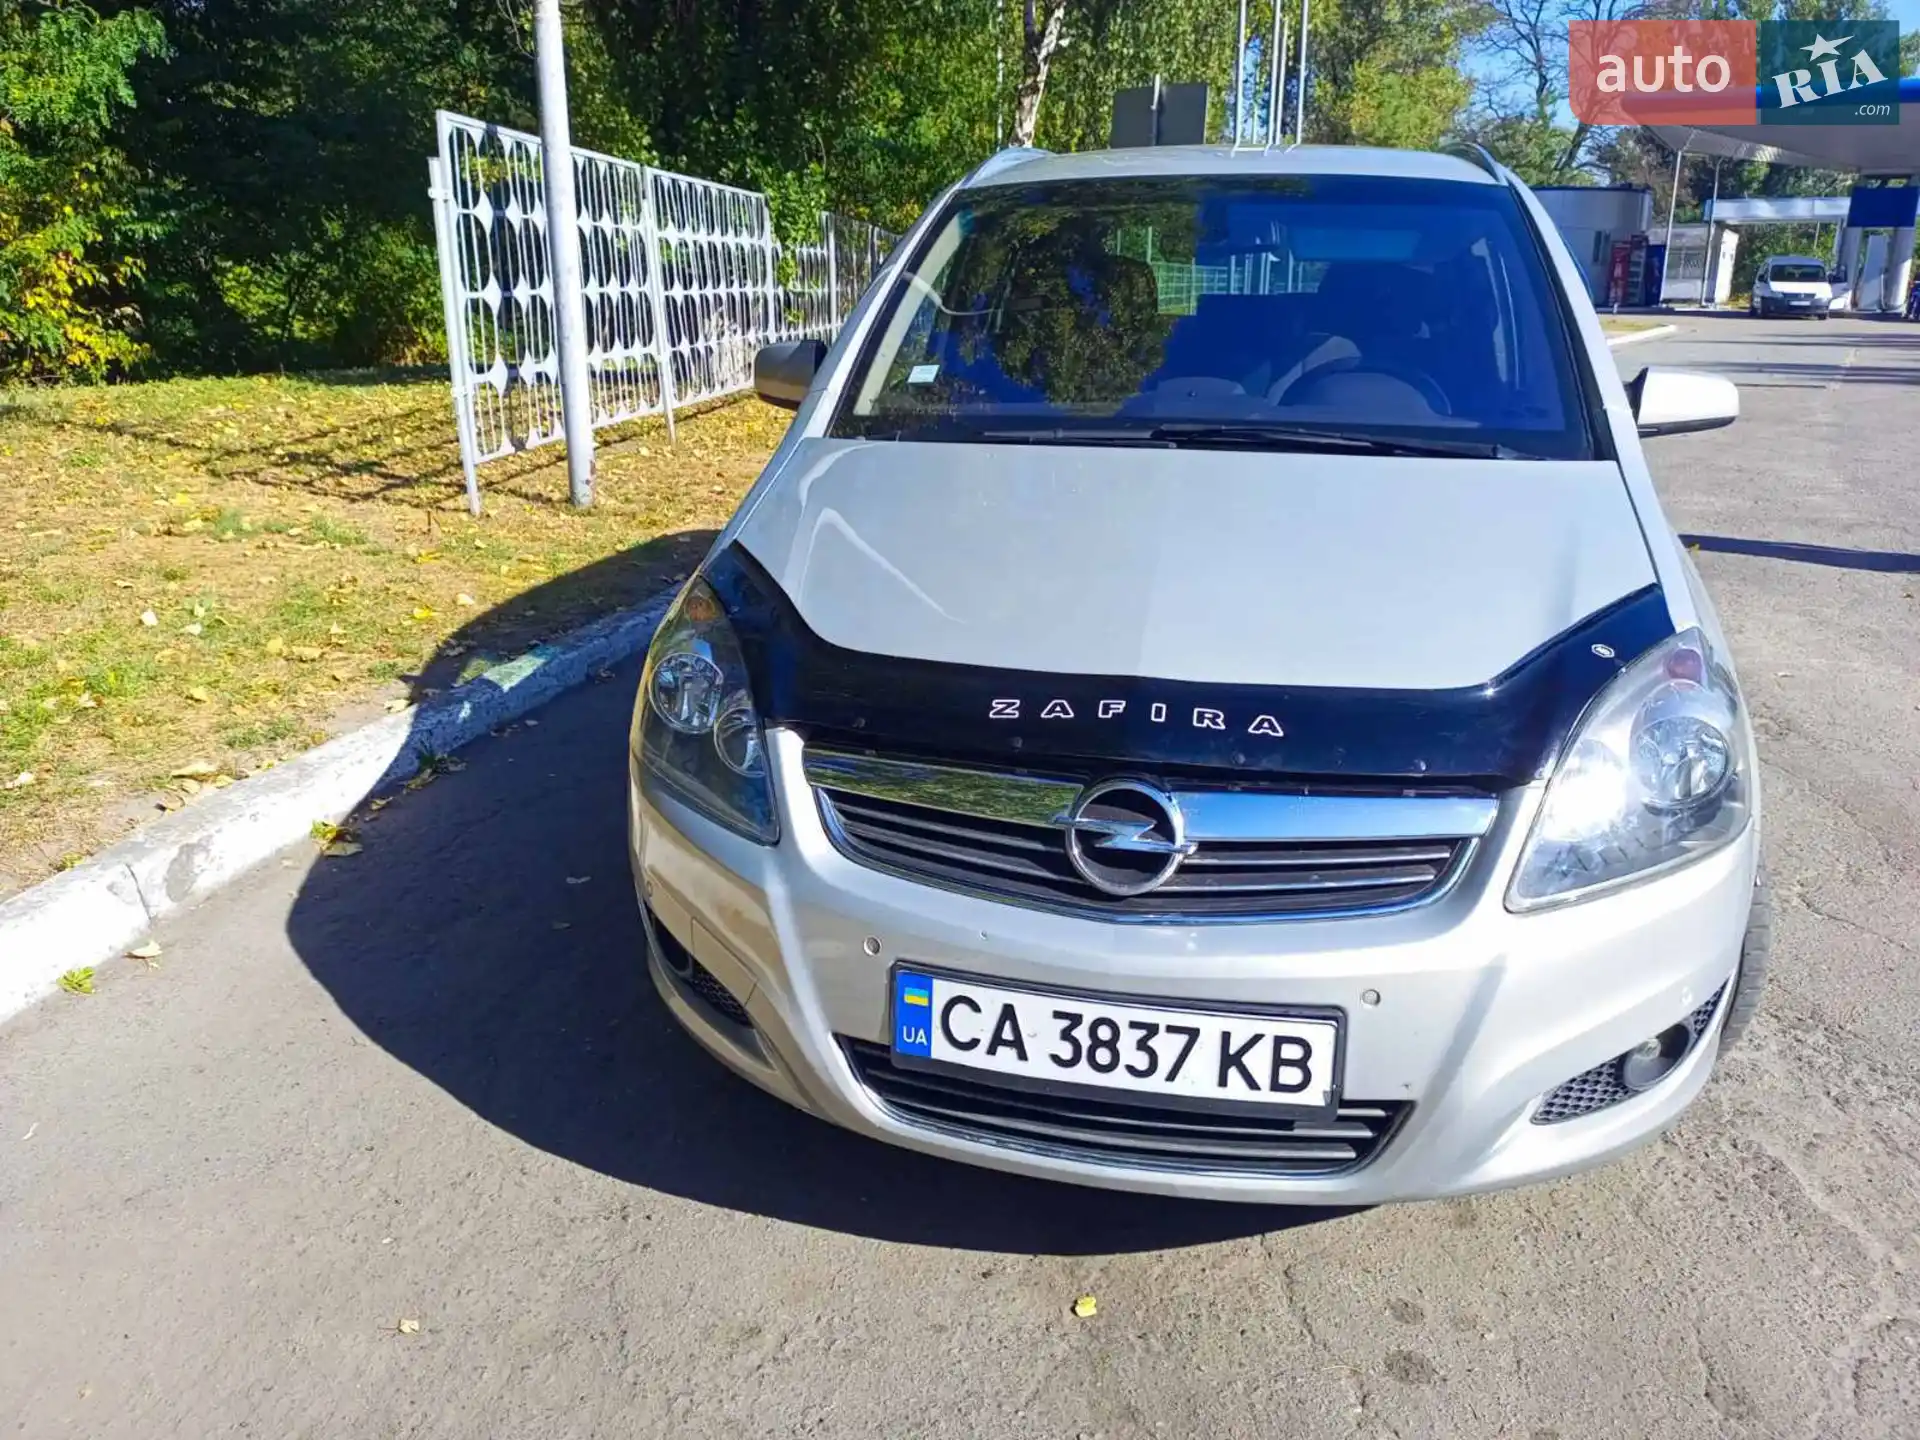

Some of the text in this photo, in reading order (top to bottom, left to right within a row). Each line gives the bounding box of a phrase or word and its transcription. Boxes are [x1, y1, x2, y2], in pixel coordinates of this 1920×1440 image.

[989, 699, 1284, 737] ZAFIRA
[902, 1025, 928, 1046] UA
[940, 994, 1313, 1093] CA 3837 KB
